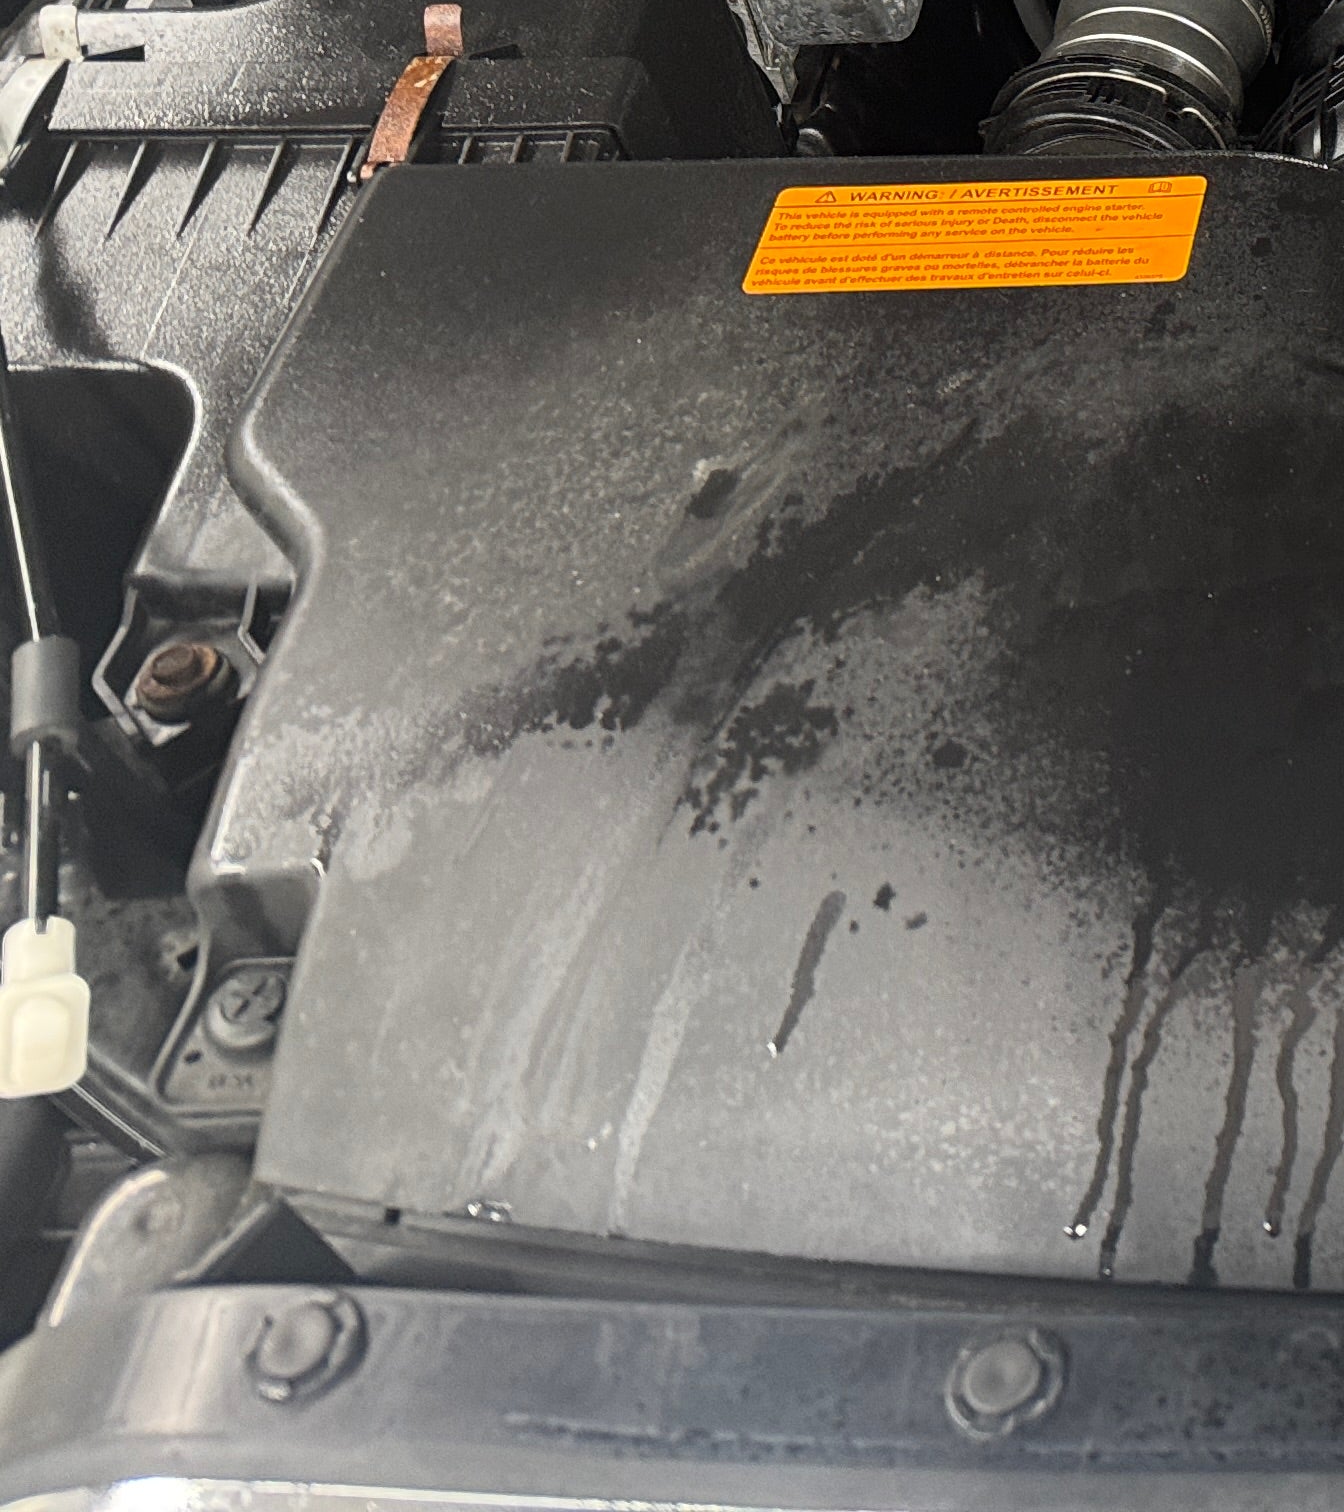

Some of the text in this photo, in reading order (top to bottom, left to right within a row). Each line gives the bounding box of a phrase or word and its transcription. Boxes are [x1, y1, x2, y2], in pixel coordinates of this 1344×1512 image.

[960, 185, 1118, 199] AVERTISSEMENT
[778, 212, 801, 220] This
[805, 211, 847, 219] vehicle
[850, 211, 859, 219] is
[862, 209, 916, 220] equipped
[920, 208, 944, 217] with
[958, 207, 998, 216] remote
[1001, 205, 1060, 214] controlled
[1063, 204, 1101, 213] engine
[775, 223, 788, 231] To
[790, 222, 830, 230] reduce
[833, 221, 852, 229] the
[854, 220, 876, 228] risk
[879, 220, 893, 228] of
[894, 219, 938, 228] serious
[1032, 214, 1098, 224] disconnect
[1101, 213, 1119, 222] the
[1122, 212, 1163, 221] vehicle
[769, 233, 809, 242] battery
[813, 231, 850, 240] before
[853, 230, 917, 240] performing
[920, 230, 941, 239] any
[944, 228, 987, 237] service
[1008, 226, 1027, 234] the
[760, 256, 776, 265] Ce
[779, 255, 827, 264] véhicule
[830, 254, 848, 263] est
[909, 251, 969, 260] démarreur
[1040, 248, 1069, 257] Pour
[1072, 246, 1114, 255] réduire
[1116, 246, 1134, 254] les
[755, 267, 799, 276] risques
[802, 265, 818, 274] de
[820, 264, 878, 274] blessures
[880, 263, 920, 273] graves
[1004, 258, 1069, 268] débrancher
[1072, 257, 1083, 266] la
[1086, 257, 1131, 266] batterie
[1133, 256, 1150, 265] du
[751, 278, 801, 287] véhicule
[803, 276, 837, 285] avant
[906, 274, 927, 282] des
[930, 273, 974, 282] travaux
